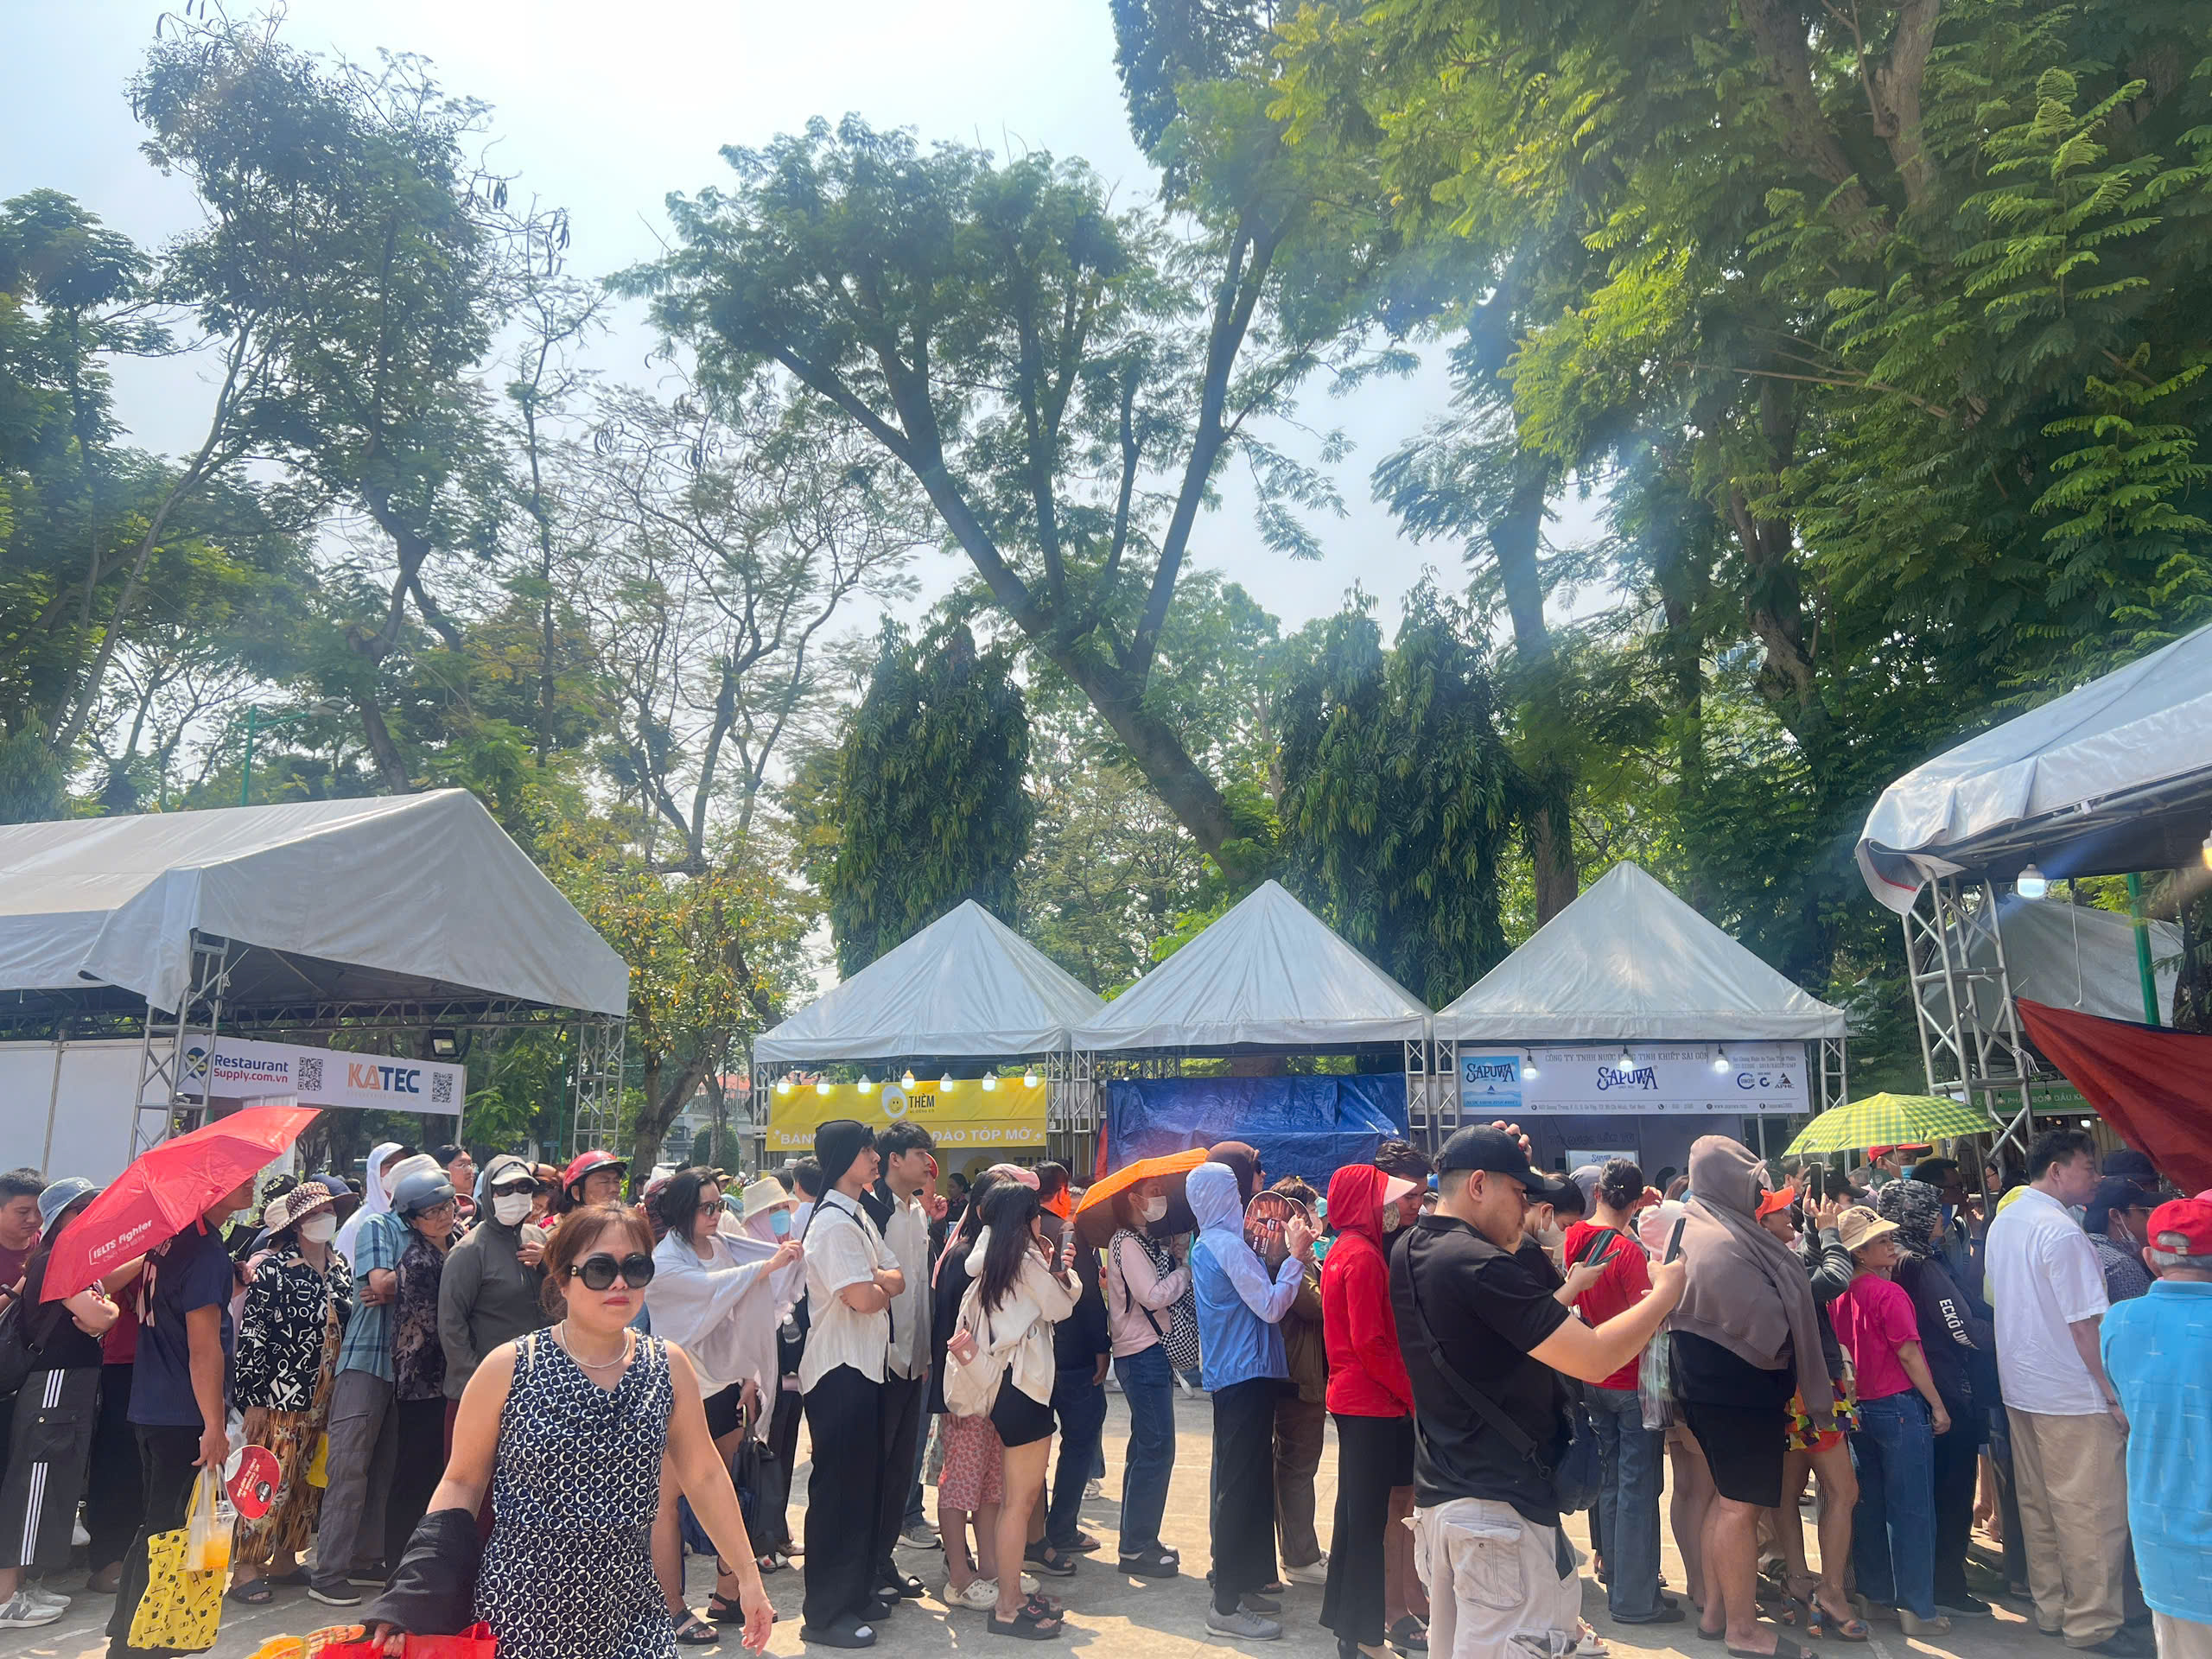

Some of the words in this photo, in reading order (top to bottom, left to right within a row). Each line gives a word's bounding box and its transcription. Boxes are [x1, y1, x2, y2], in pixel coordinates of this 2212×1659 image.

[214, 1054, 289, 1072] Restaurant
[1465, 1063, 1515, 1083] SAPUWA
[213, 1068, 289, 1084] Supply.com.vn
[347, 1062, 421, 1093] KATEC
[1597, 1065, 1659, 1090] SAPUWA
[908, 1092, 935, 1108] THÈM
[92, 1238, 117, 1259] IELTS
[118, 1218, 152, 1244] Fighter
